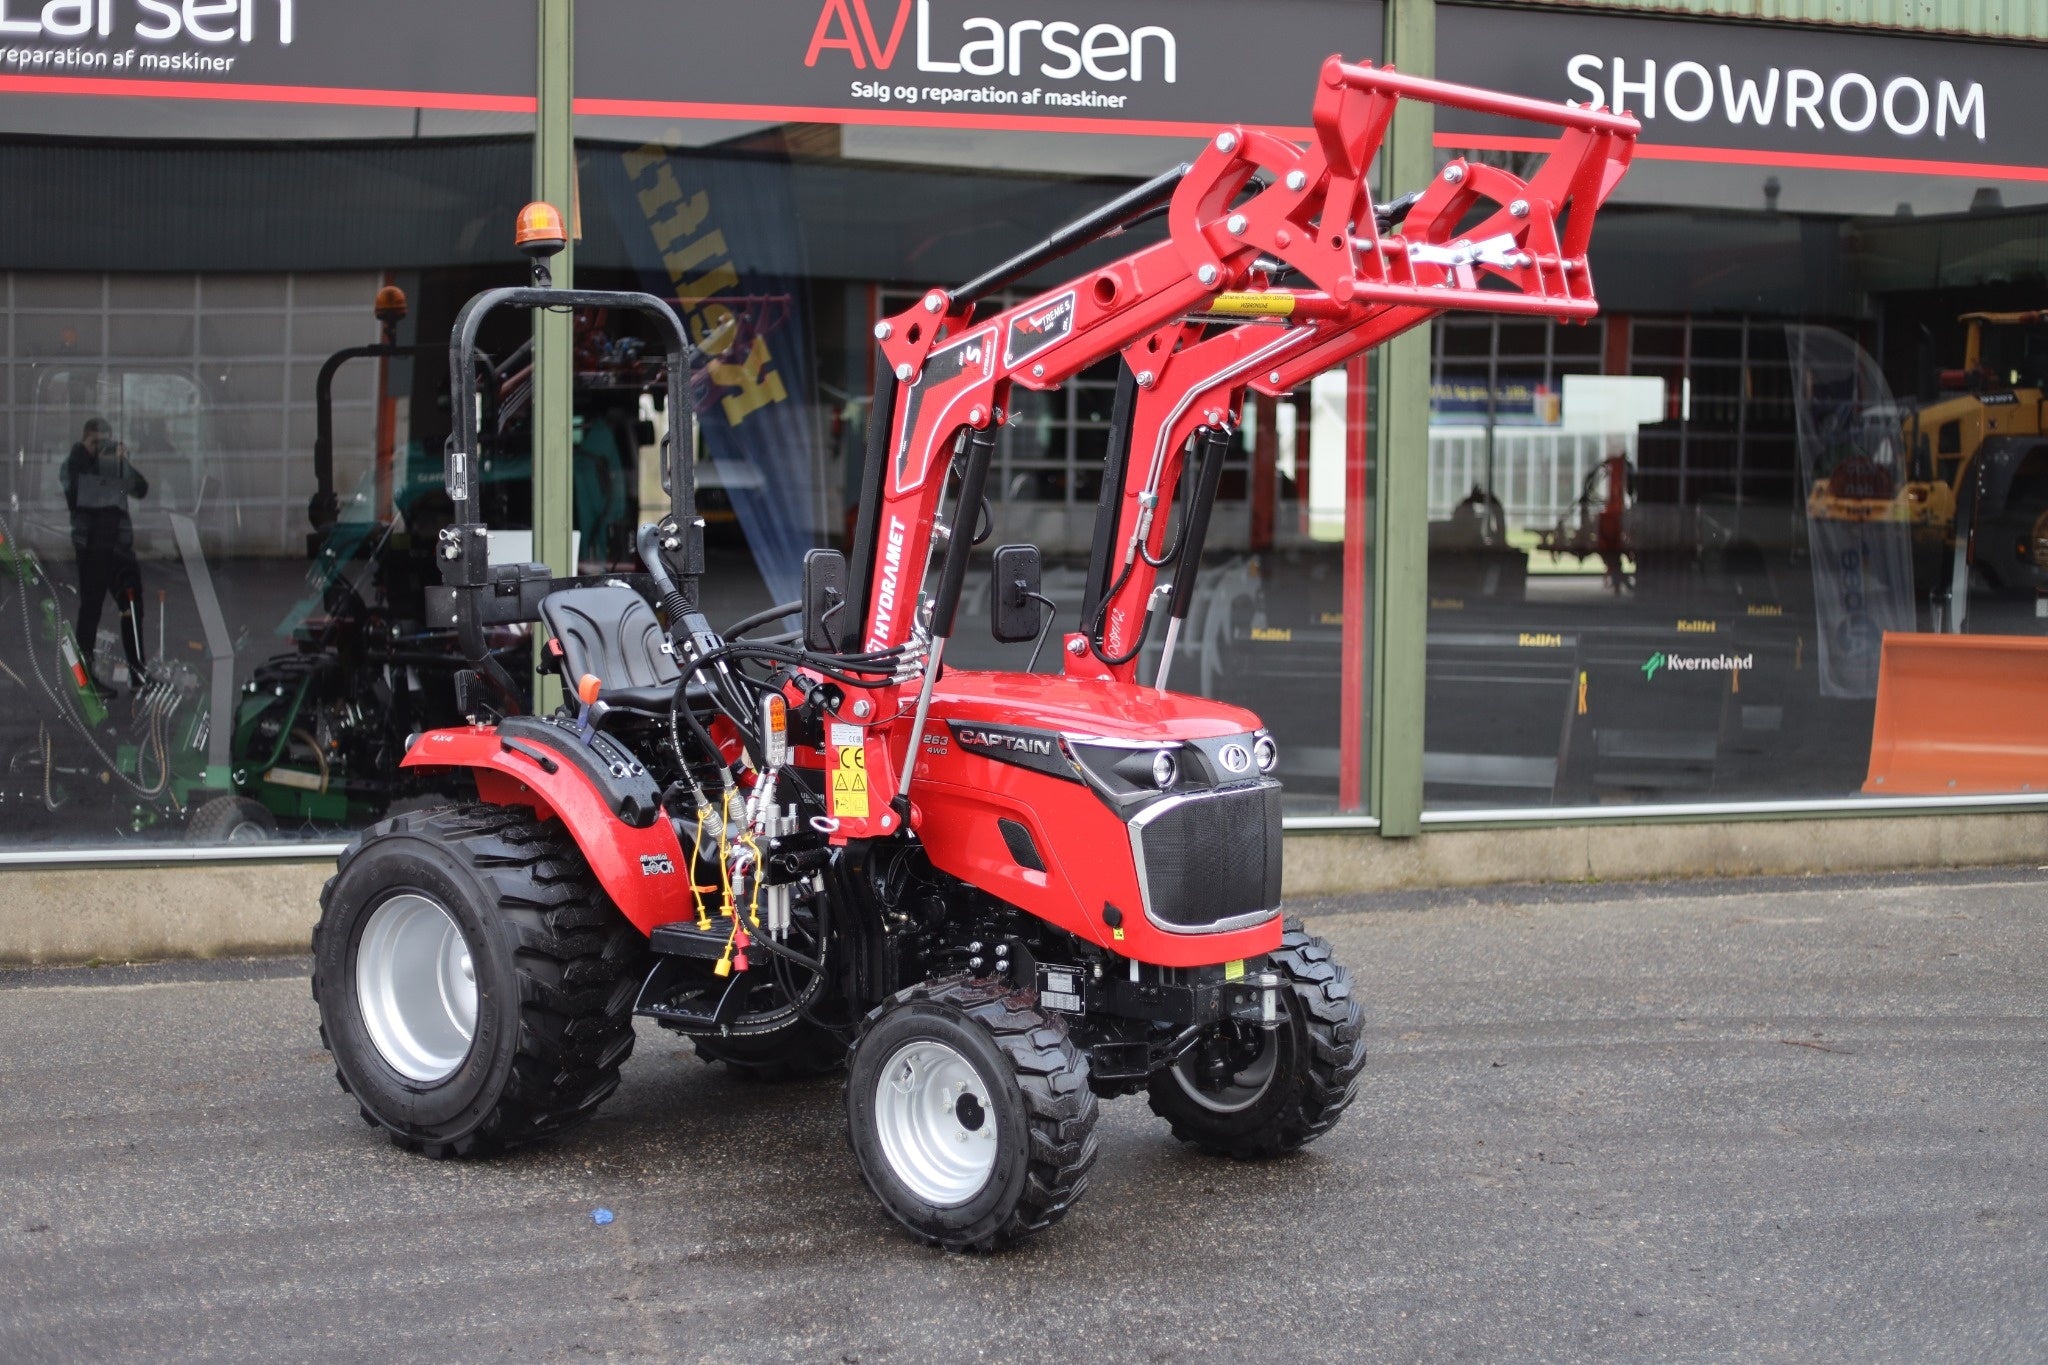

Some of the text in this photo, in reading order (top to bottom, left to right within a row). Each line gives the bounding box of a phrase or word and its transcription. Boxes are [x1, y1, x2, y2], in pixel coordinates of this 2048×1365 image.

[804, 0, 1177, 83] AVLarsen
[112, 50, 134, 67] af
[139, 53, 234, 71] maskiner
[851, 81, 1127, 108] Salg og reparation af maskiner
[1566, 53, 1987, 140] SHOWROOM
[874, 515, 906, 640] HYDRAMET
[1677, 619, 1716, 633] Kellfri
[1519, 632, 1561, 648] Kellfri
[1667, 653, 1753, 671] Kverneland
[922, 734, 949, 746] 263
[959, 729, 1051, 756] CAPTAIN
[840, 747, 865, 769] CE
[926, 747, 948, 755] 4WD
